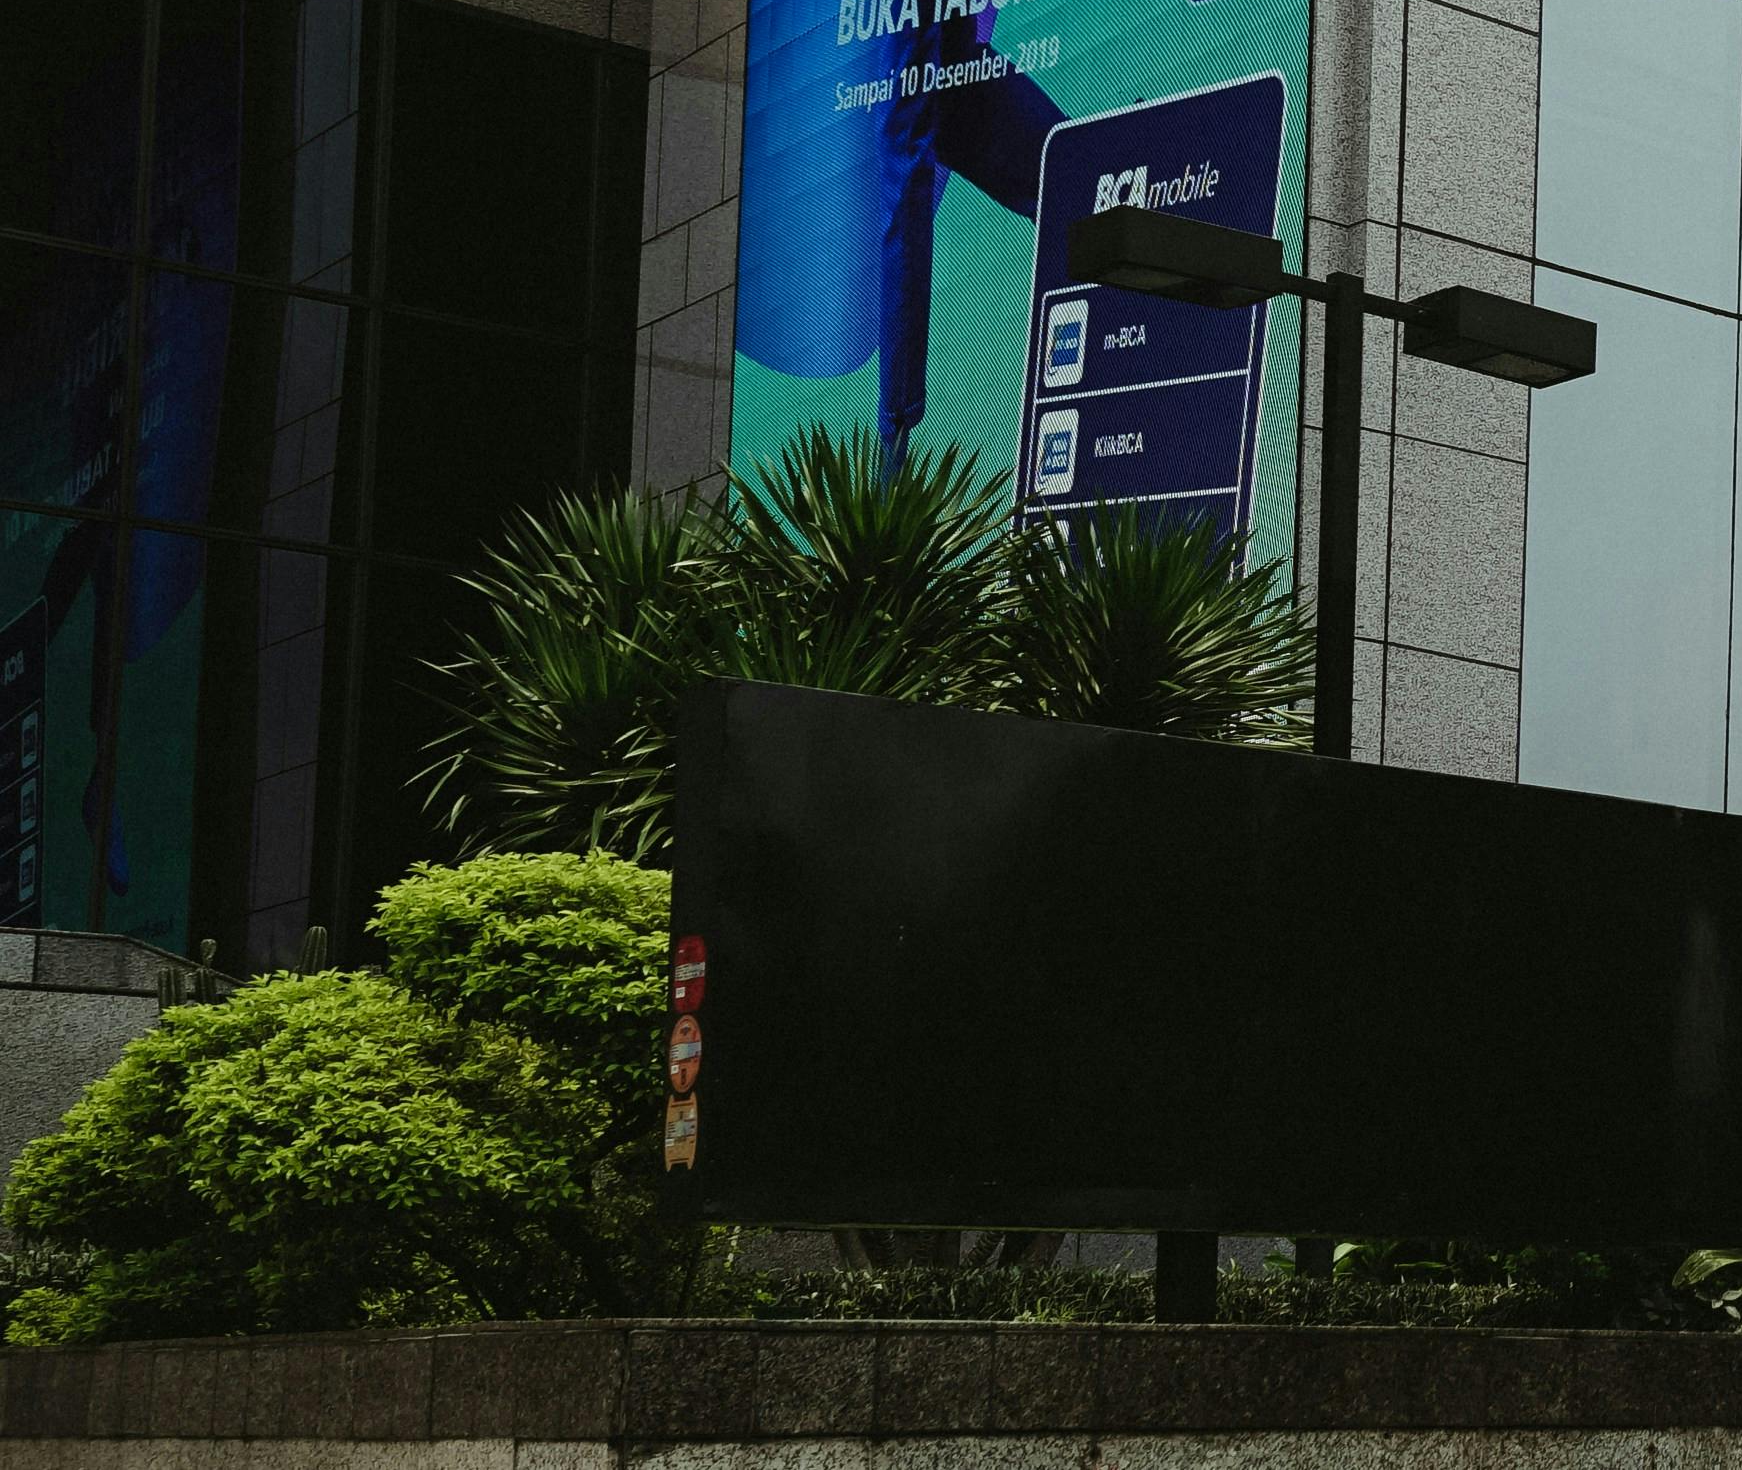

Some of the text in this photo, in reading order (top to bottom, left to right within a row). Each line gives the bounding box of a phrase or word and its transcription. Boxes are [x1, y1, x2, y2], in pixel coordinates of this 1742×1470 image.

[834, 34, 1061, 112] Sampai 10 Desember 2019
